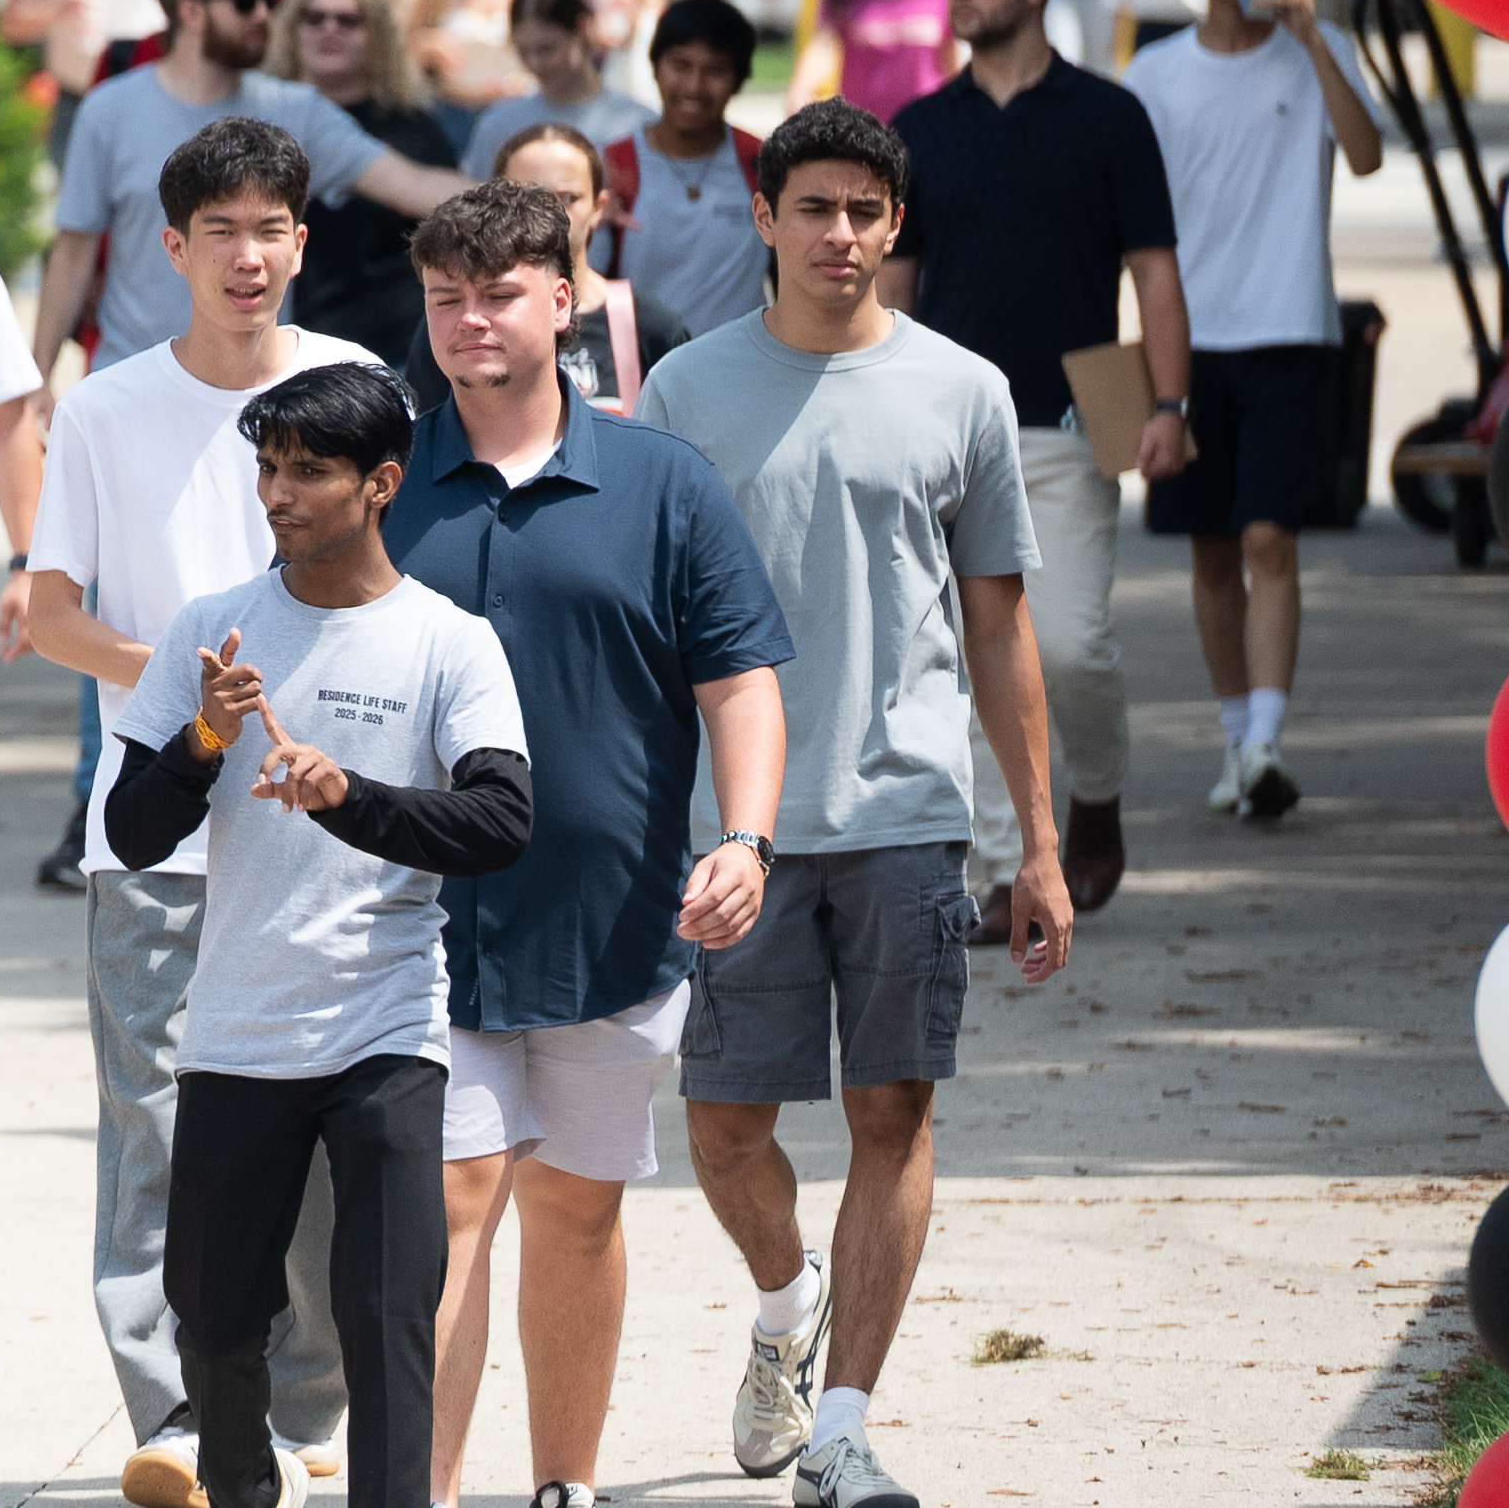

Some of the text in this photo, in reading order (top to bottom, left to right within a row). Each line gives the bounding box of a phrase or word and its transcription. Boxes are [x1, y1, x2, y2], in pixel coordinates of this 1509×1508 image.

[318, 689, 407, 714] RESIDENCE LIFE STAFF
